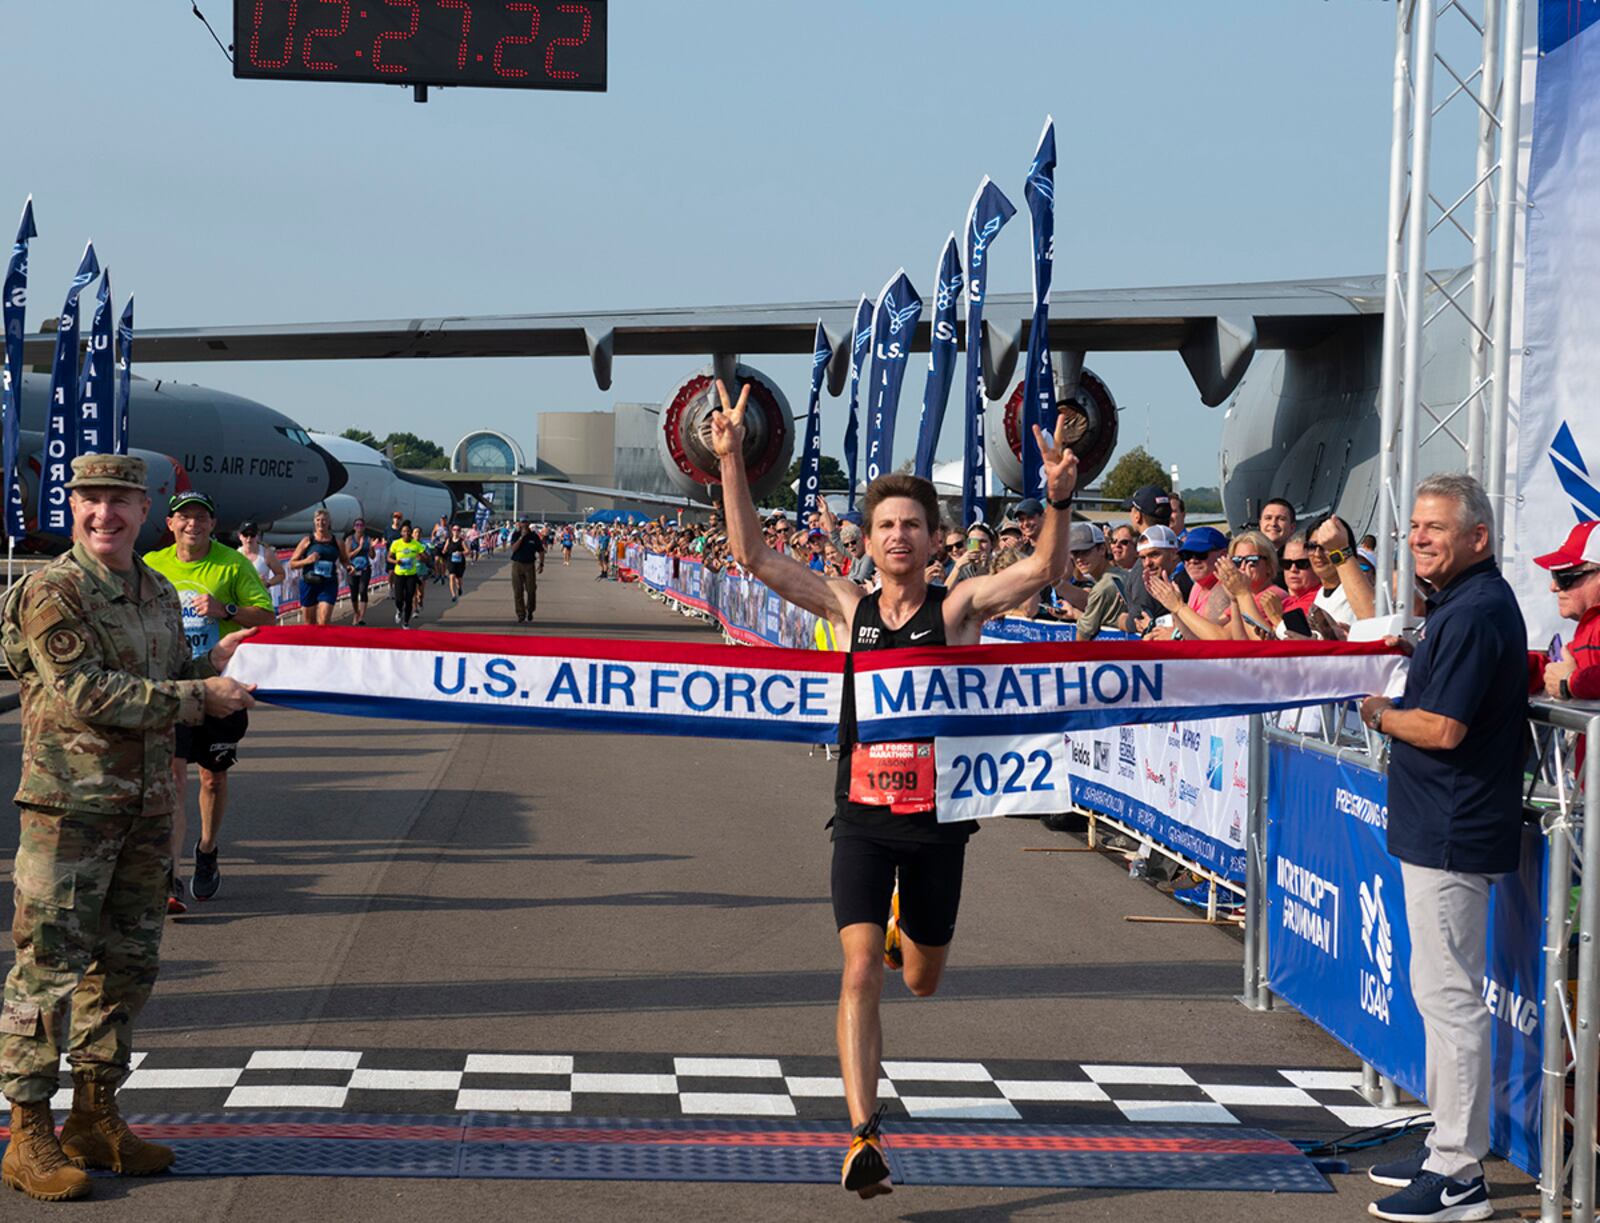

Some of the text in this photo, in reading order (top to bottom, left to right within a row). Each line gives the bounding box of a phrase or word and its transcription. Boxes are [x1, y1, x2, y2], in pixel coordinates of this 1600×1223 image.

[220, 456, 245, 475] AIR
[249, 458, 295, 478] FORCE
[859, 626, 880, 639] DTC
[433, 656, 1164, 716] U.S. AIR FORCE MARATHON
[869, 743, 914, 752] AIR FORCE
[867, 769, 918, 790] 1099
[951, 750, 1055, 800] 2022
[1360, 968, 1390, 1025] USAA
[1482, 975, 1538, 1036] EING
